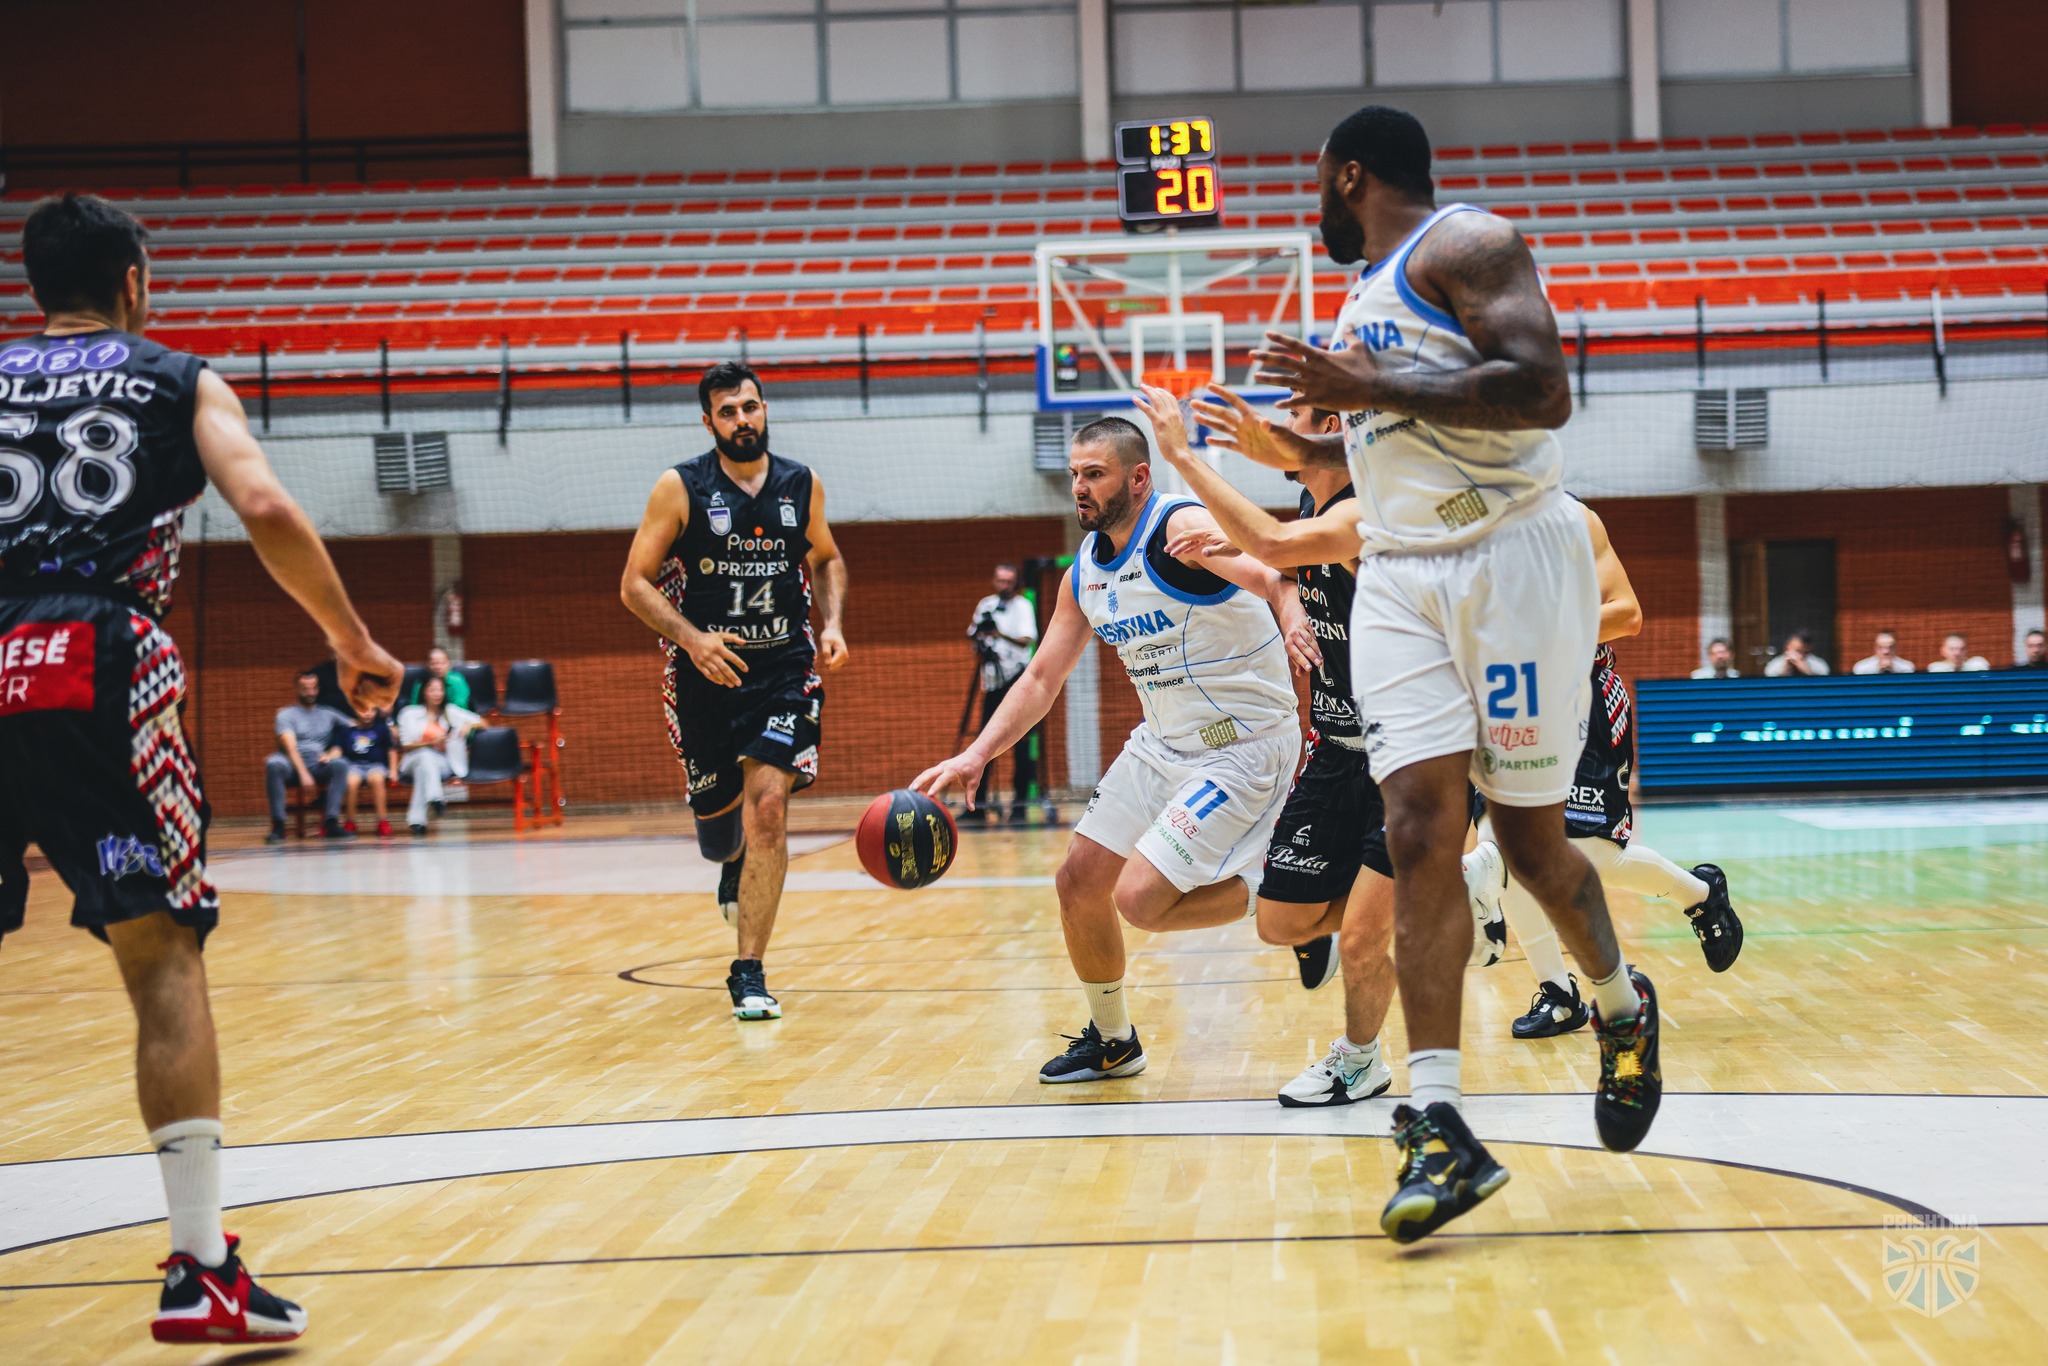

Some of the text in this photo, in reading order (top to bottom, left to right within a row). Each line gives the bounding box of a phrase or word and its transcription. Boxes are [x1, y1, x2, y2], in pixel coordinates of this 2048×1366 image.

[1150, 120, 1211, 155] 1:37
[1156, 166, 1215, 215] 20
[1375, 418, 1416, 438] finance
[727, 533, 786, 551] Proton
[727, 580, 775, 617] 14
[1307, 613, 1348, 641] RENI
[1135, 646, 1178, 660] ALBERTI
[1153, 677, 1185, 690] finance
[1486, 662, 1539, 719] 21
[1488, 723, 1541, 751] vipa
[1499, 756, 1559, 771] PARTNERS
[1184, 780, 1229, 820] 11
[1566, 802, 1605, 813] Automobile
[1567, 785, 1605, 806] REX
[1158, 827, 1194, 866] PARTNERS
